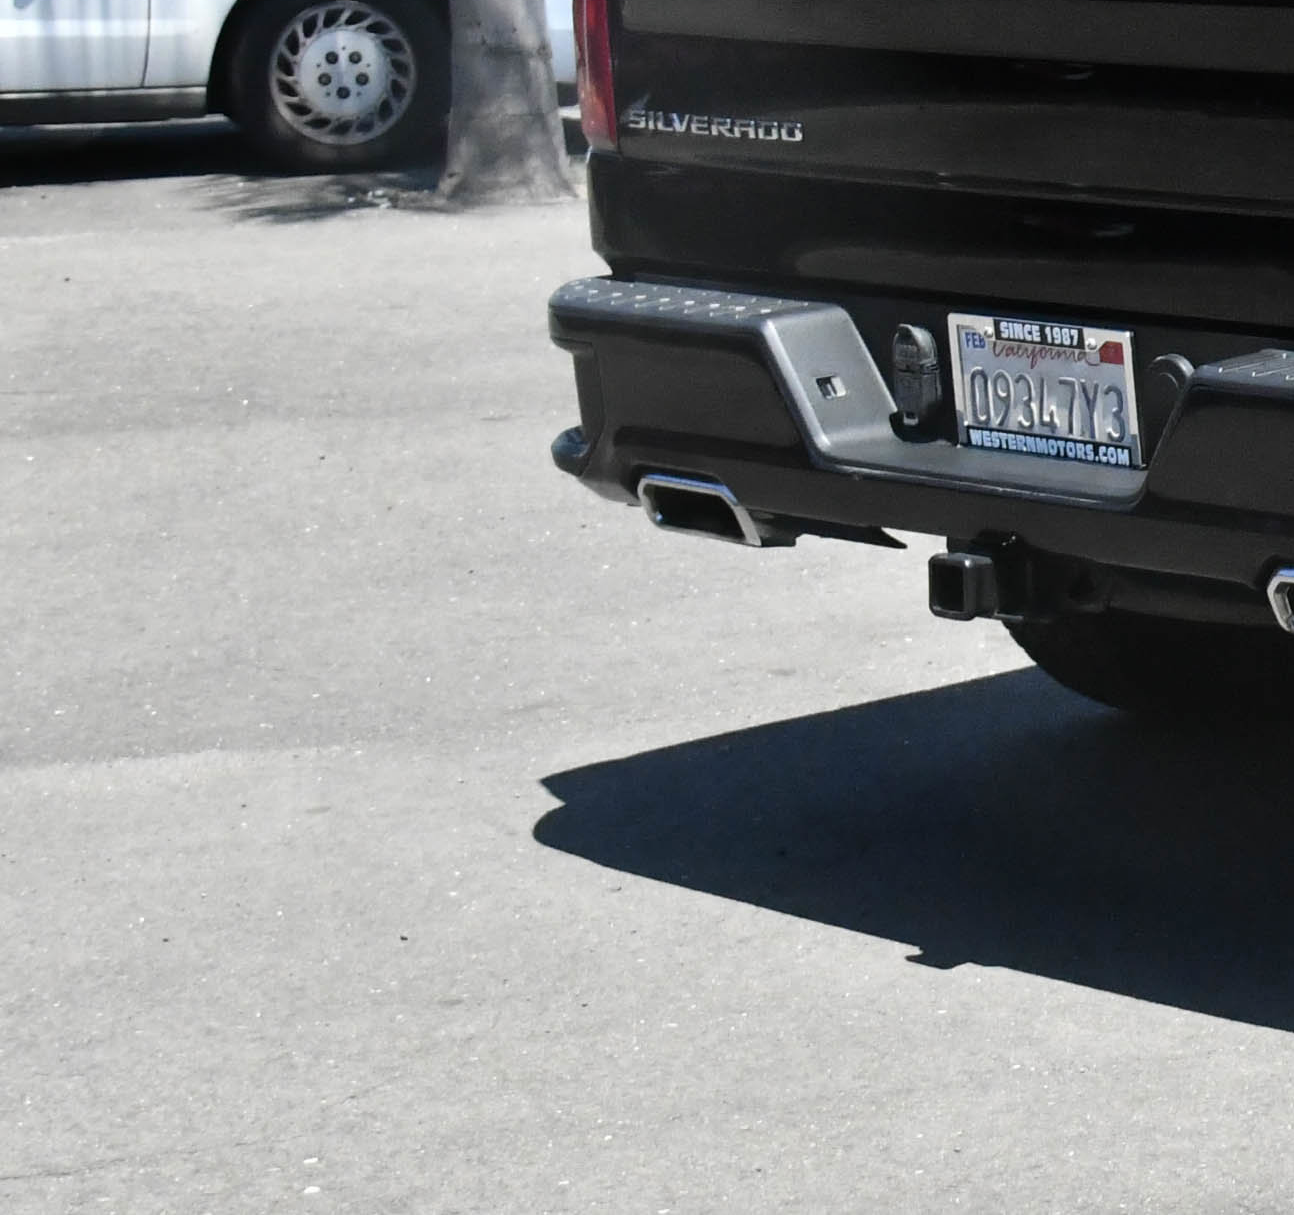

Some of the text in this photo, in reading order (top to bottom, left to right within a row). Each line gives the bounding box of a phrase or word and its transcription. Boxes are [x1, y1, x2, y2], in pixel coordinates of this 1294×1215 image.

[628, 109, 803, 143] SILVERADO
[999, 321, 1079, 346] SINCE 1987
[970, 366, 1126, 443] 09347Y3
[969, 428, 1130, 465] WESTERNMOTORS.COM
